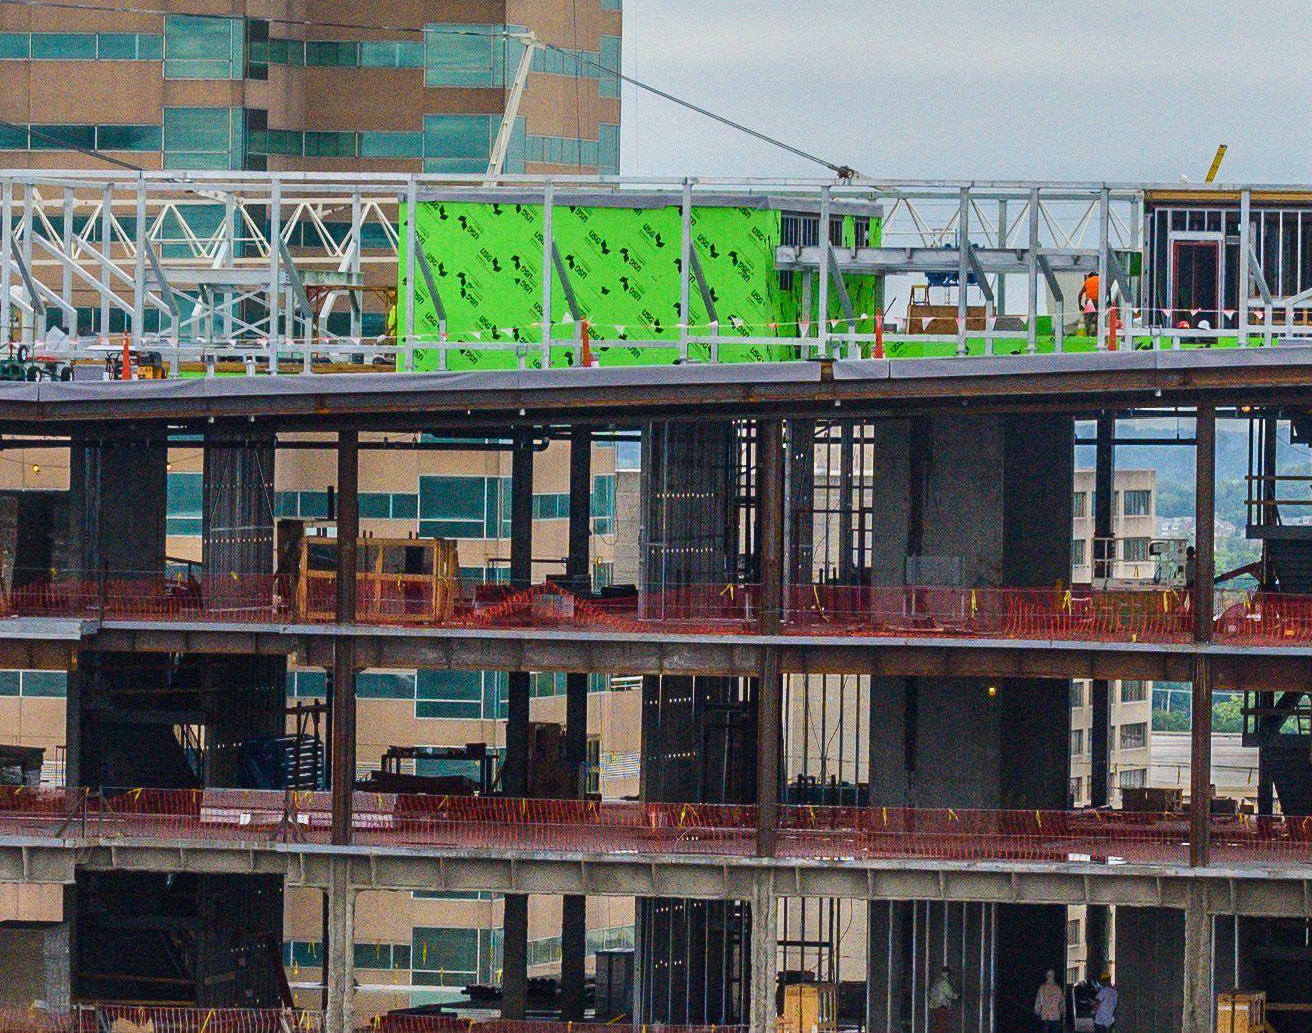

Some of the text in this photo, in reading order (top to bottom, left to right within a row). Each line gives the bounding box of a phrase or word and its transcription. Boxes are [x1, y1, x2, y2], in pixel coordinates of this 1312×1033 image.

[521, 209, 533, 223] USG
[575, 207, 588, 222] USG
[467, 226, 479, 239] USG
[643, 223, 656, 238] USG
[752, 226, 765, 241] USG
[589, 231, 601, 245] USG
[697, 234, 710, 249] USG
[480, 248, 493, 262] USG
[520, 266, 532, 278] USG
[574, 265, 586, 279] USG
[628, 258, 641, 272] USG
[520, 280, 532, 293] USG
[628, 286, 641, 301] USG
[465, 294, 478, 307] USG
[751, 290, 764, 305] USG
[425, 313, 438, 327] USG
[480, 316, 492, 330] USG
[642, 310, 655, 323] USG
[464, 351, 477, 364] USG
[750, 347, 763, 362] USG
